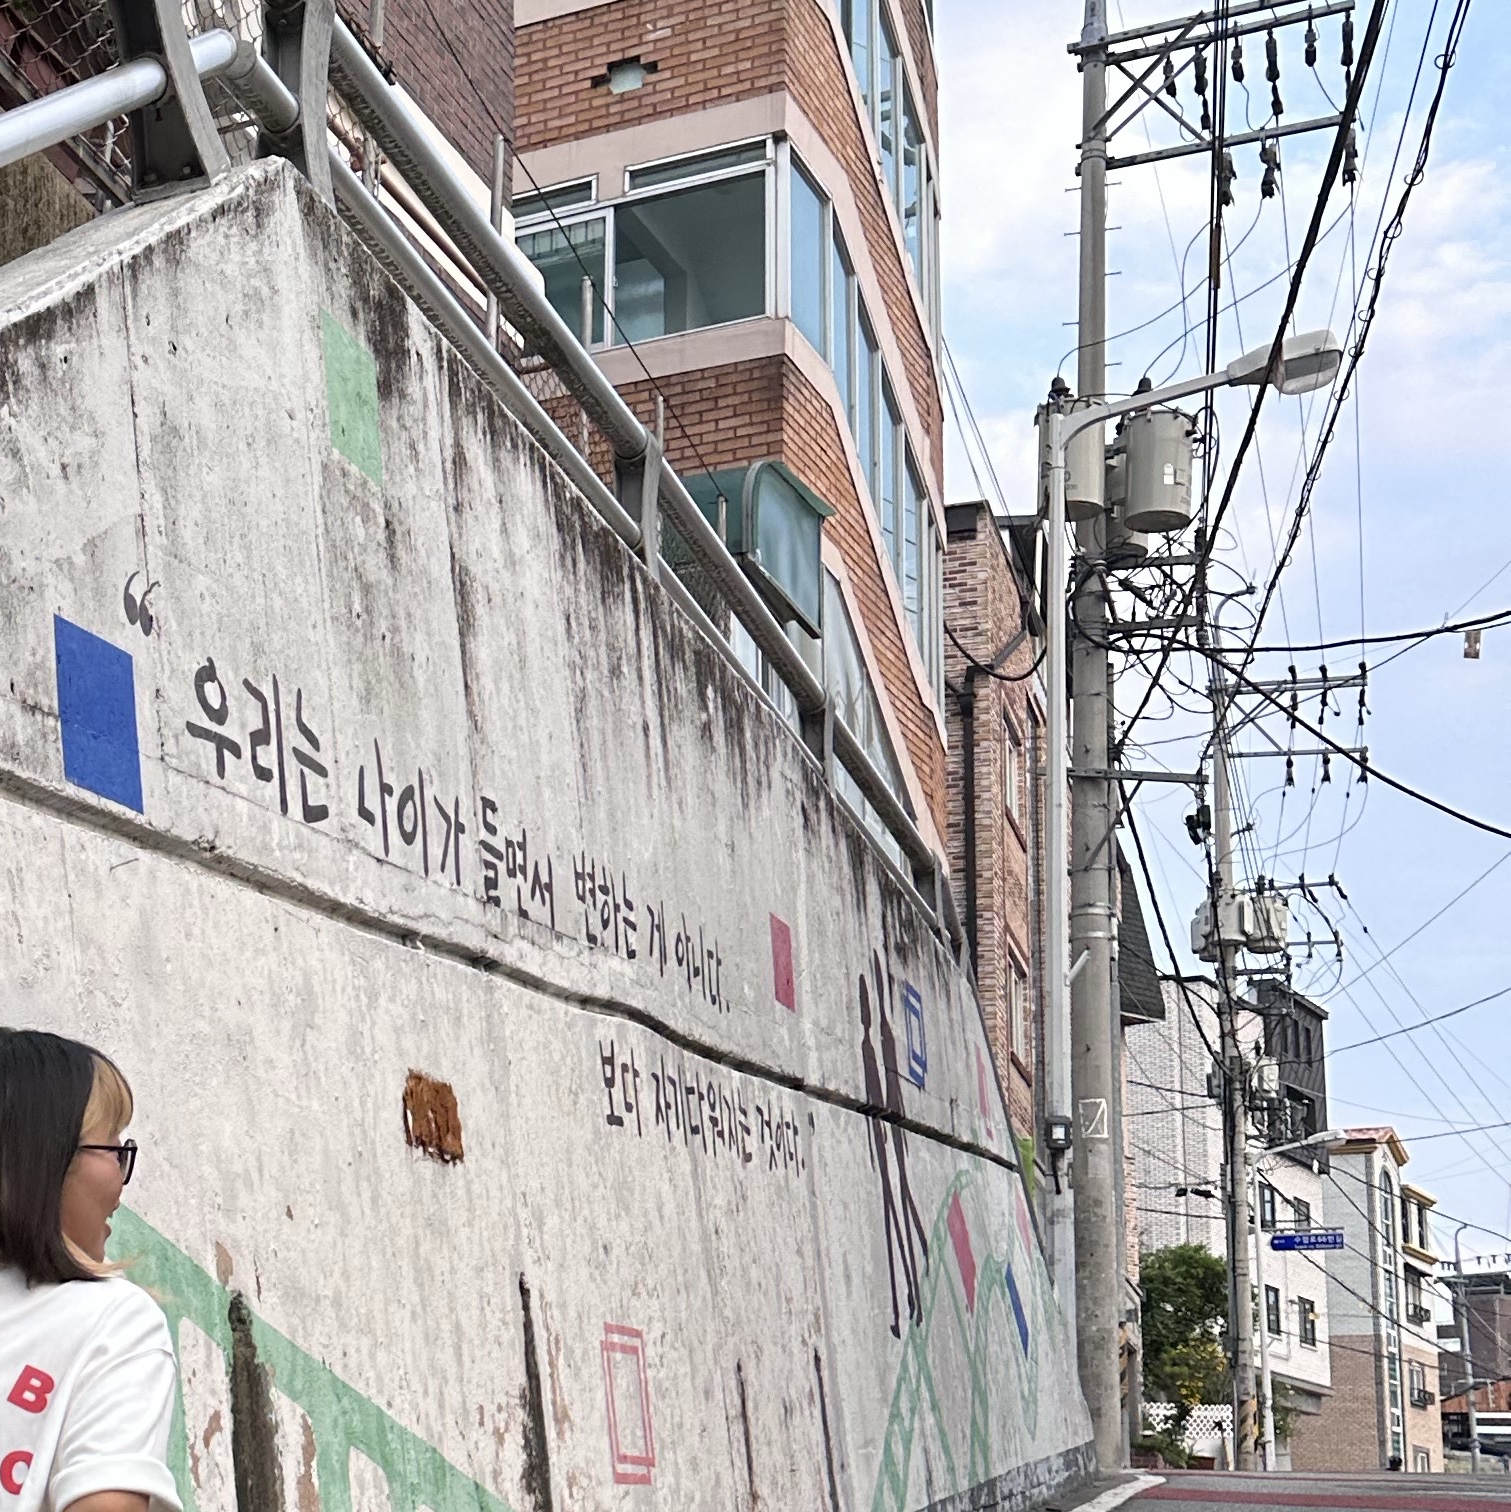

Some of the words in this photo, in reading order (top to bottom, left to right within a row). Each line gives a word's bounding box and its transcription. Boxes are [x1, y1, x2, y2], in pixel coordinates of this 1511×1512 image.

[186, 656, 329, 823] 우리는
[357, 738, 466, 886] 나이가
[478, 796, 555, 931] 들면서
[573, 851, 637, 959] 변하는
[646, 900, 667, 978] 게
[674, 912, 730, 1014] 아니다.
[599, 1039, 642, 1138] 보다
[651, 1054, 753, 1168] 자기다워지는
